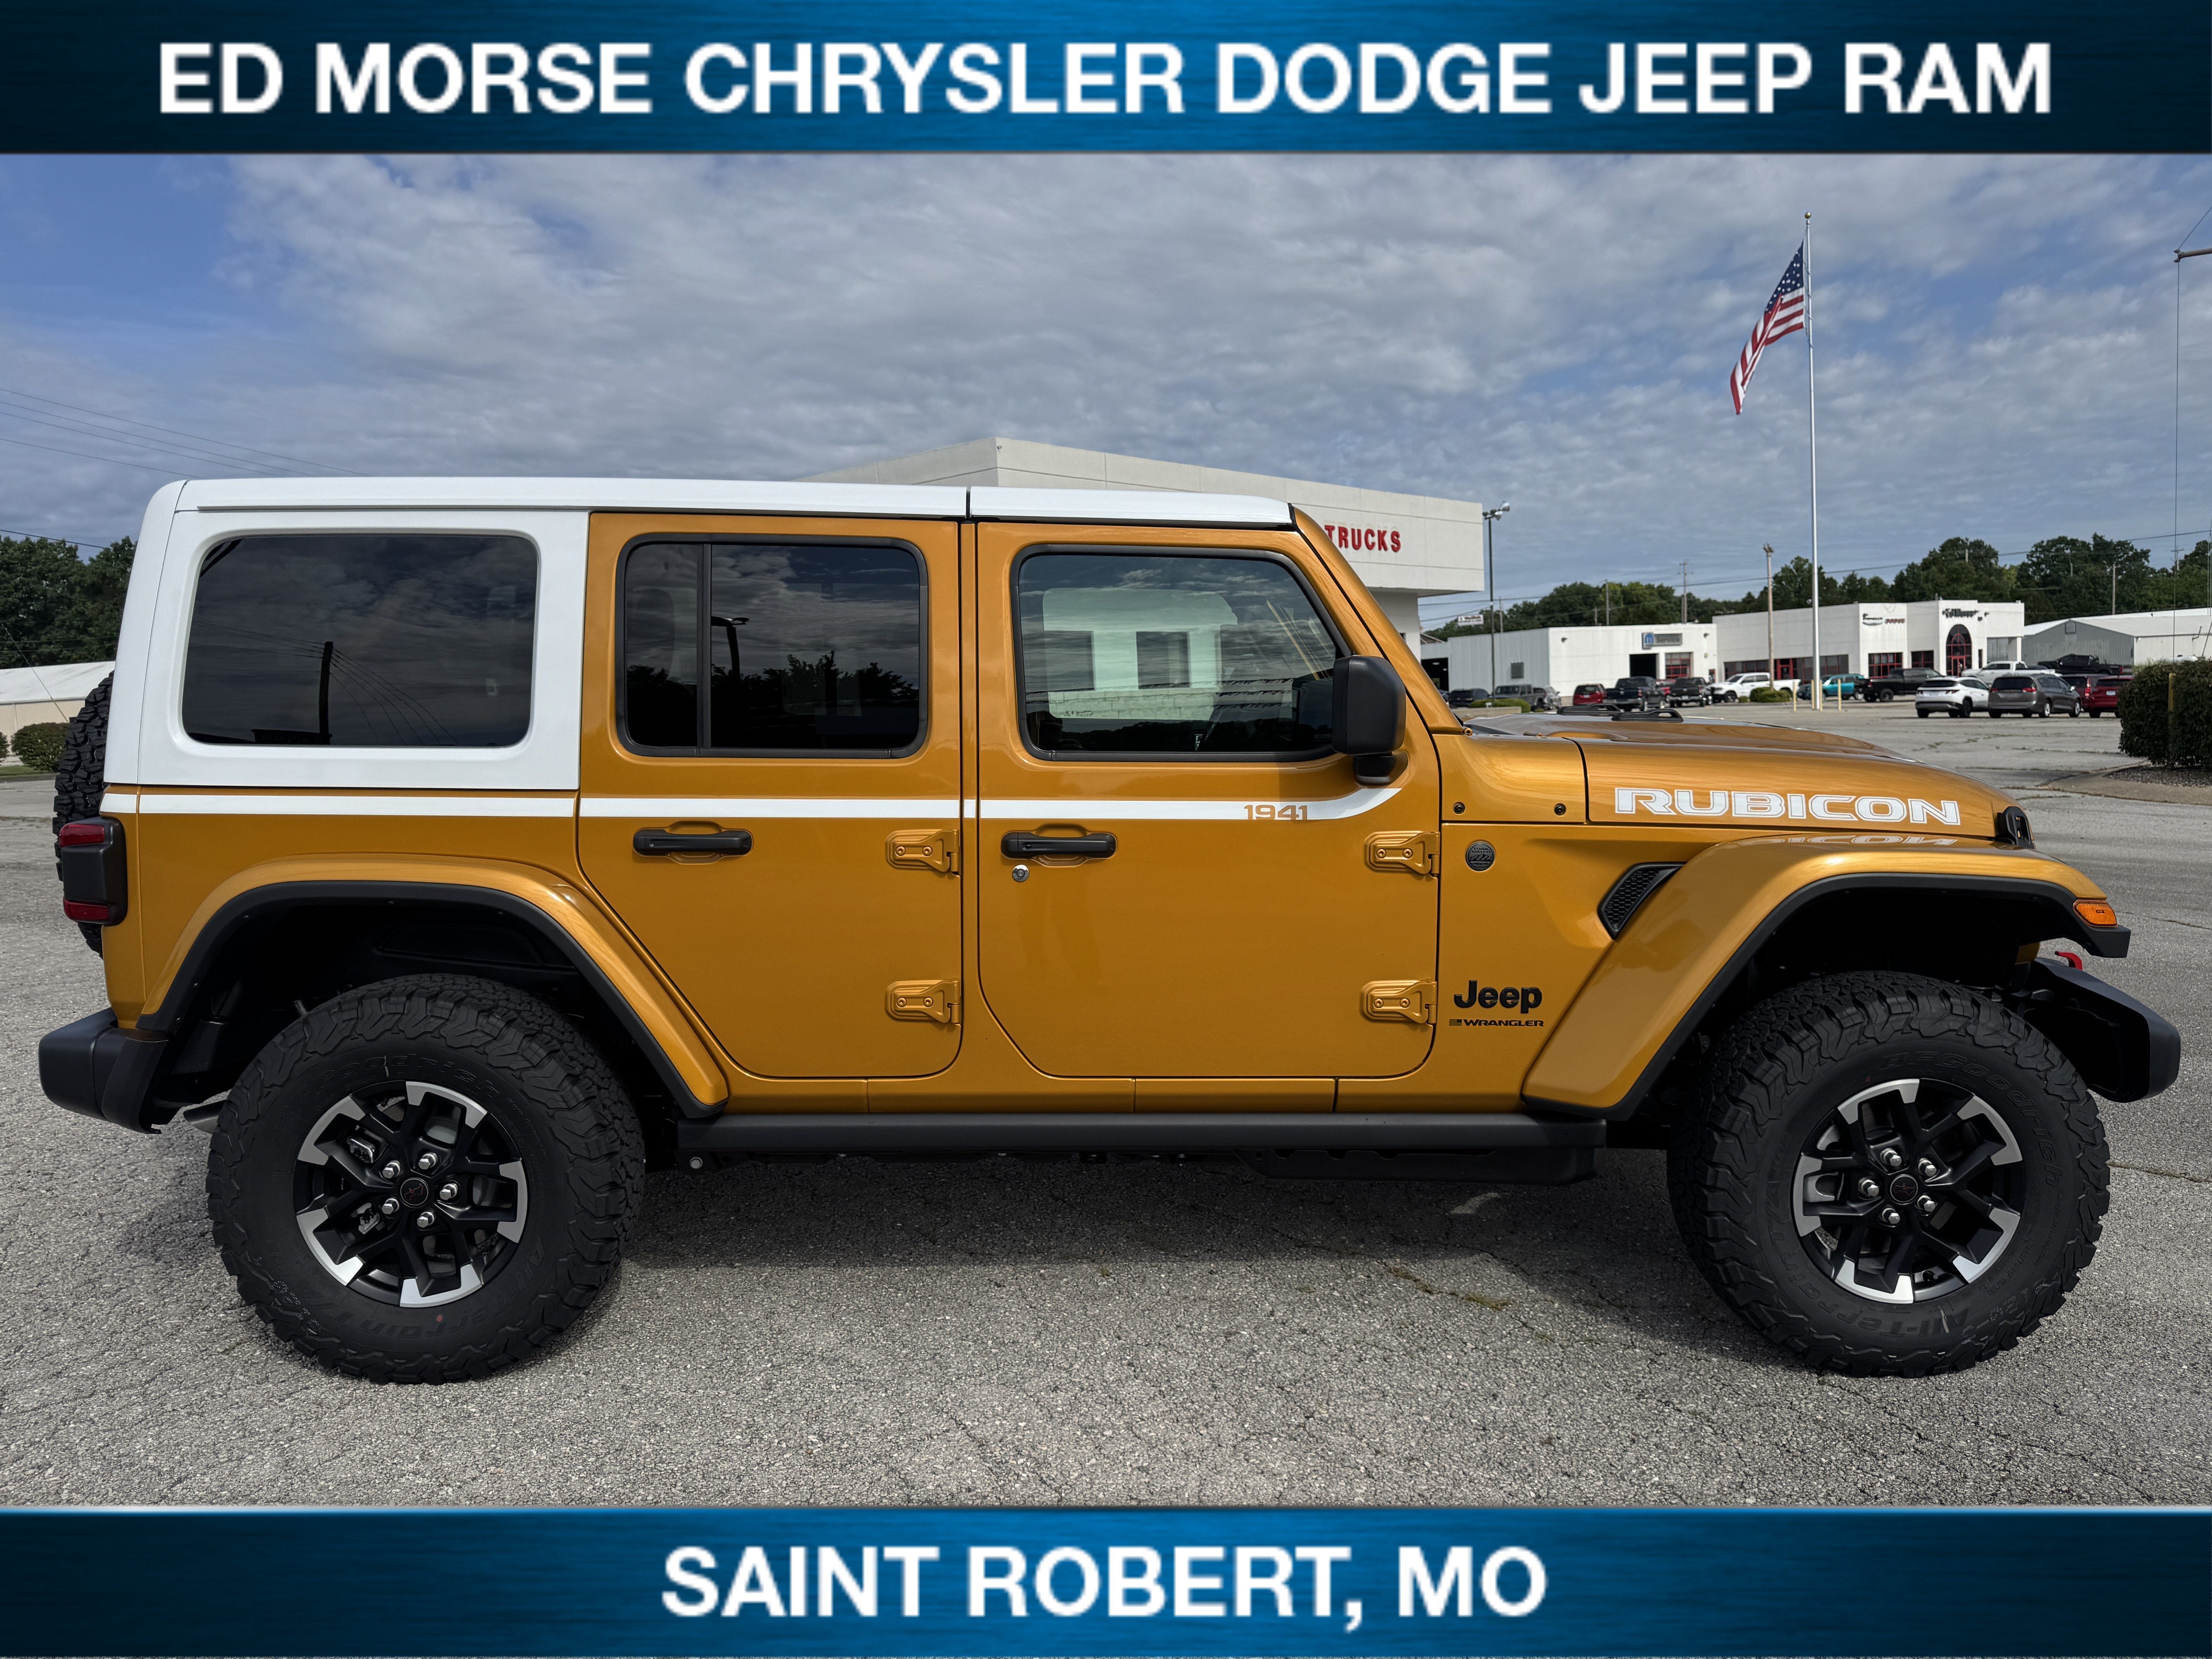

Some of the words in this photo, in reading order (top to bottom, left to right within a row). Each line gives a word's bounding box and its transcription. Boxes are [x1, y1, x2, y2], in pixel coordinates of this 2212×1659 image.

[1324, 524, 1401, 553] TRUCKS
[1243, 804, 1308, 820] 1941
[1614, 787, 1961, 826] RUBICON
[1453, 979, 1543, 1014] Jeep
[1463, 1019, 1544, 1027] WRANGLER
